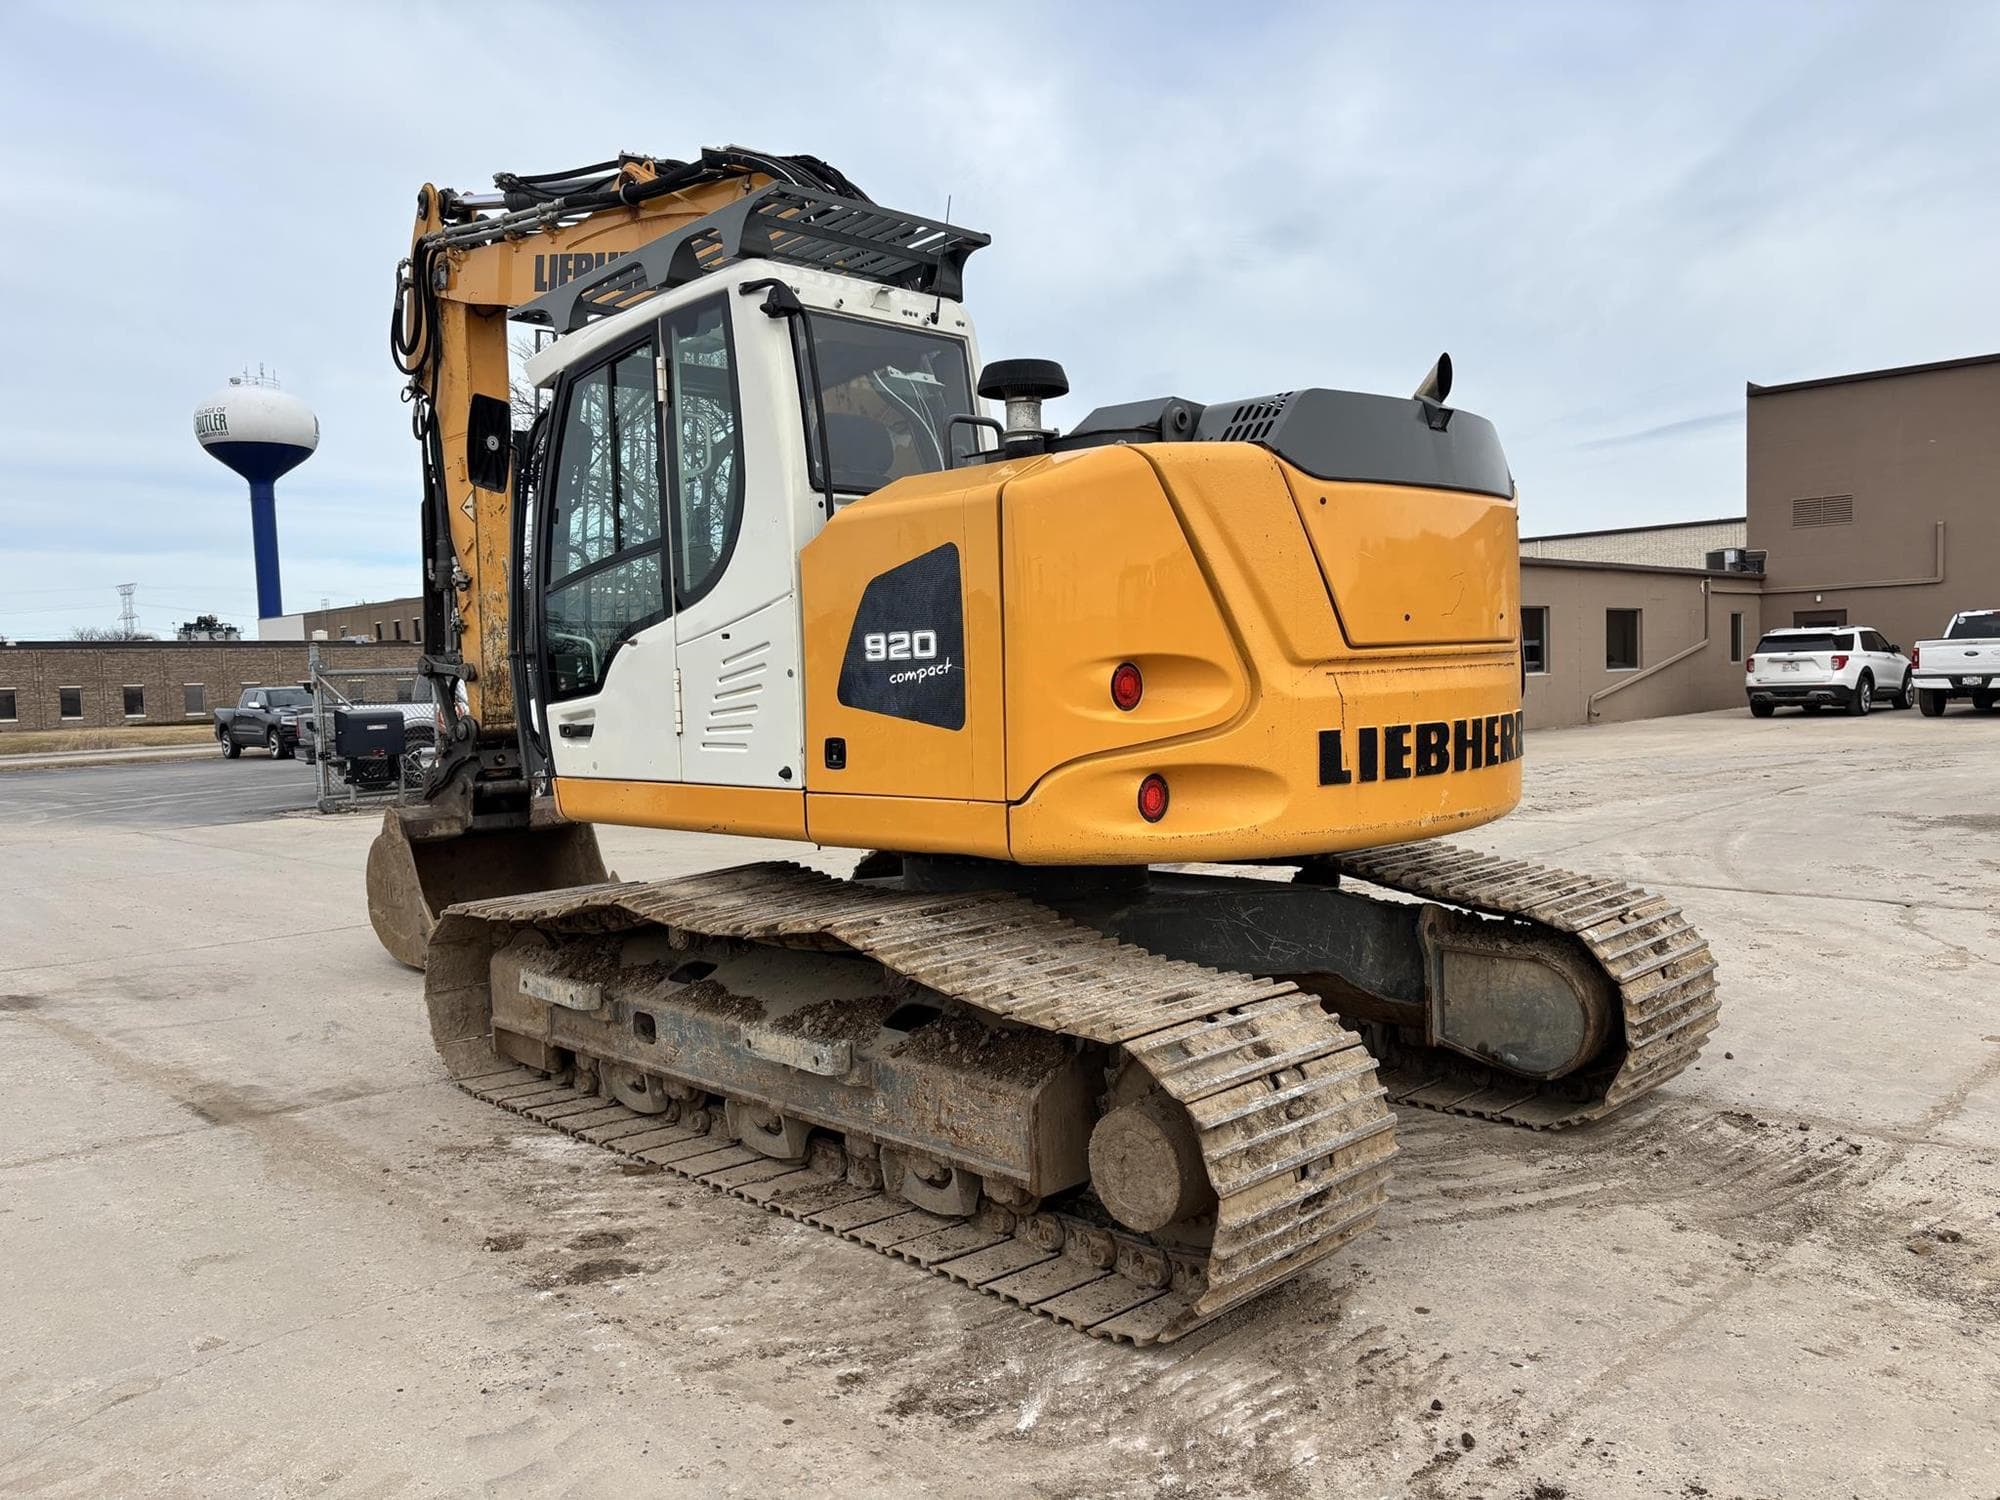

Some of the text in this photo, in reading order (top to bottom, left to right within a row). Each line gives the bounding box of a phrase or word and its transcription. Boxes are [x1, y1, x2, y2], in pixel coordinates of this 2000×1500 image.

[534, 252, 631, 292] LIEB
[864, 629, 937, 661] 920
[888, 656, 952, 684] compact
